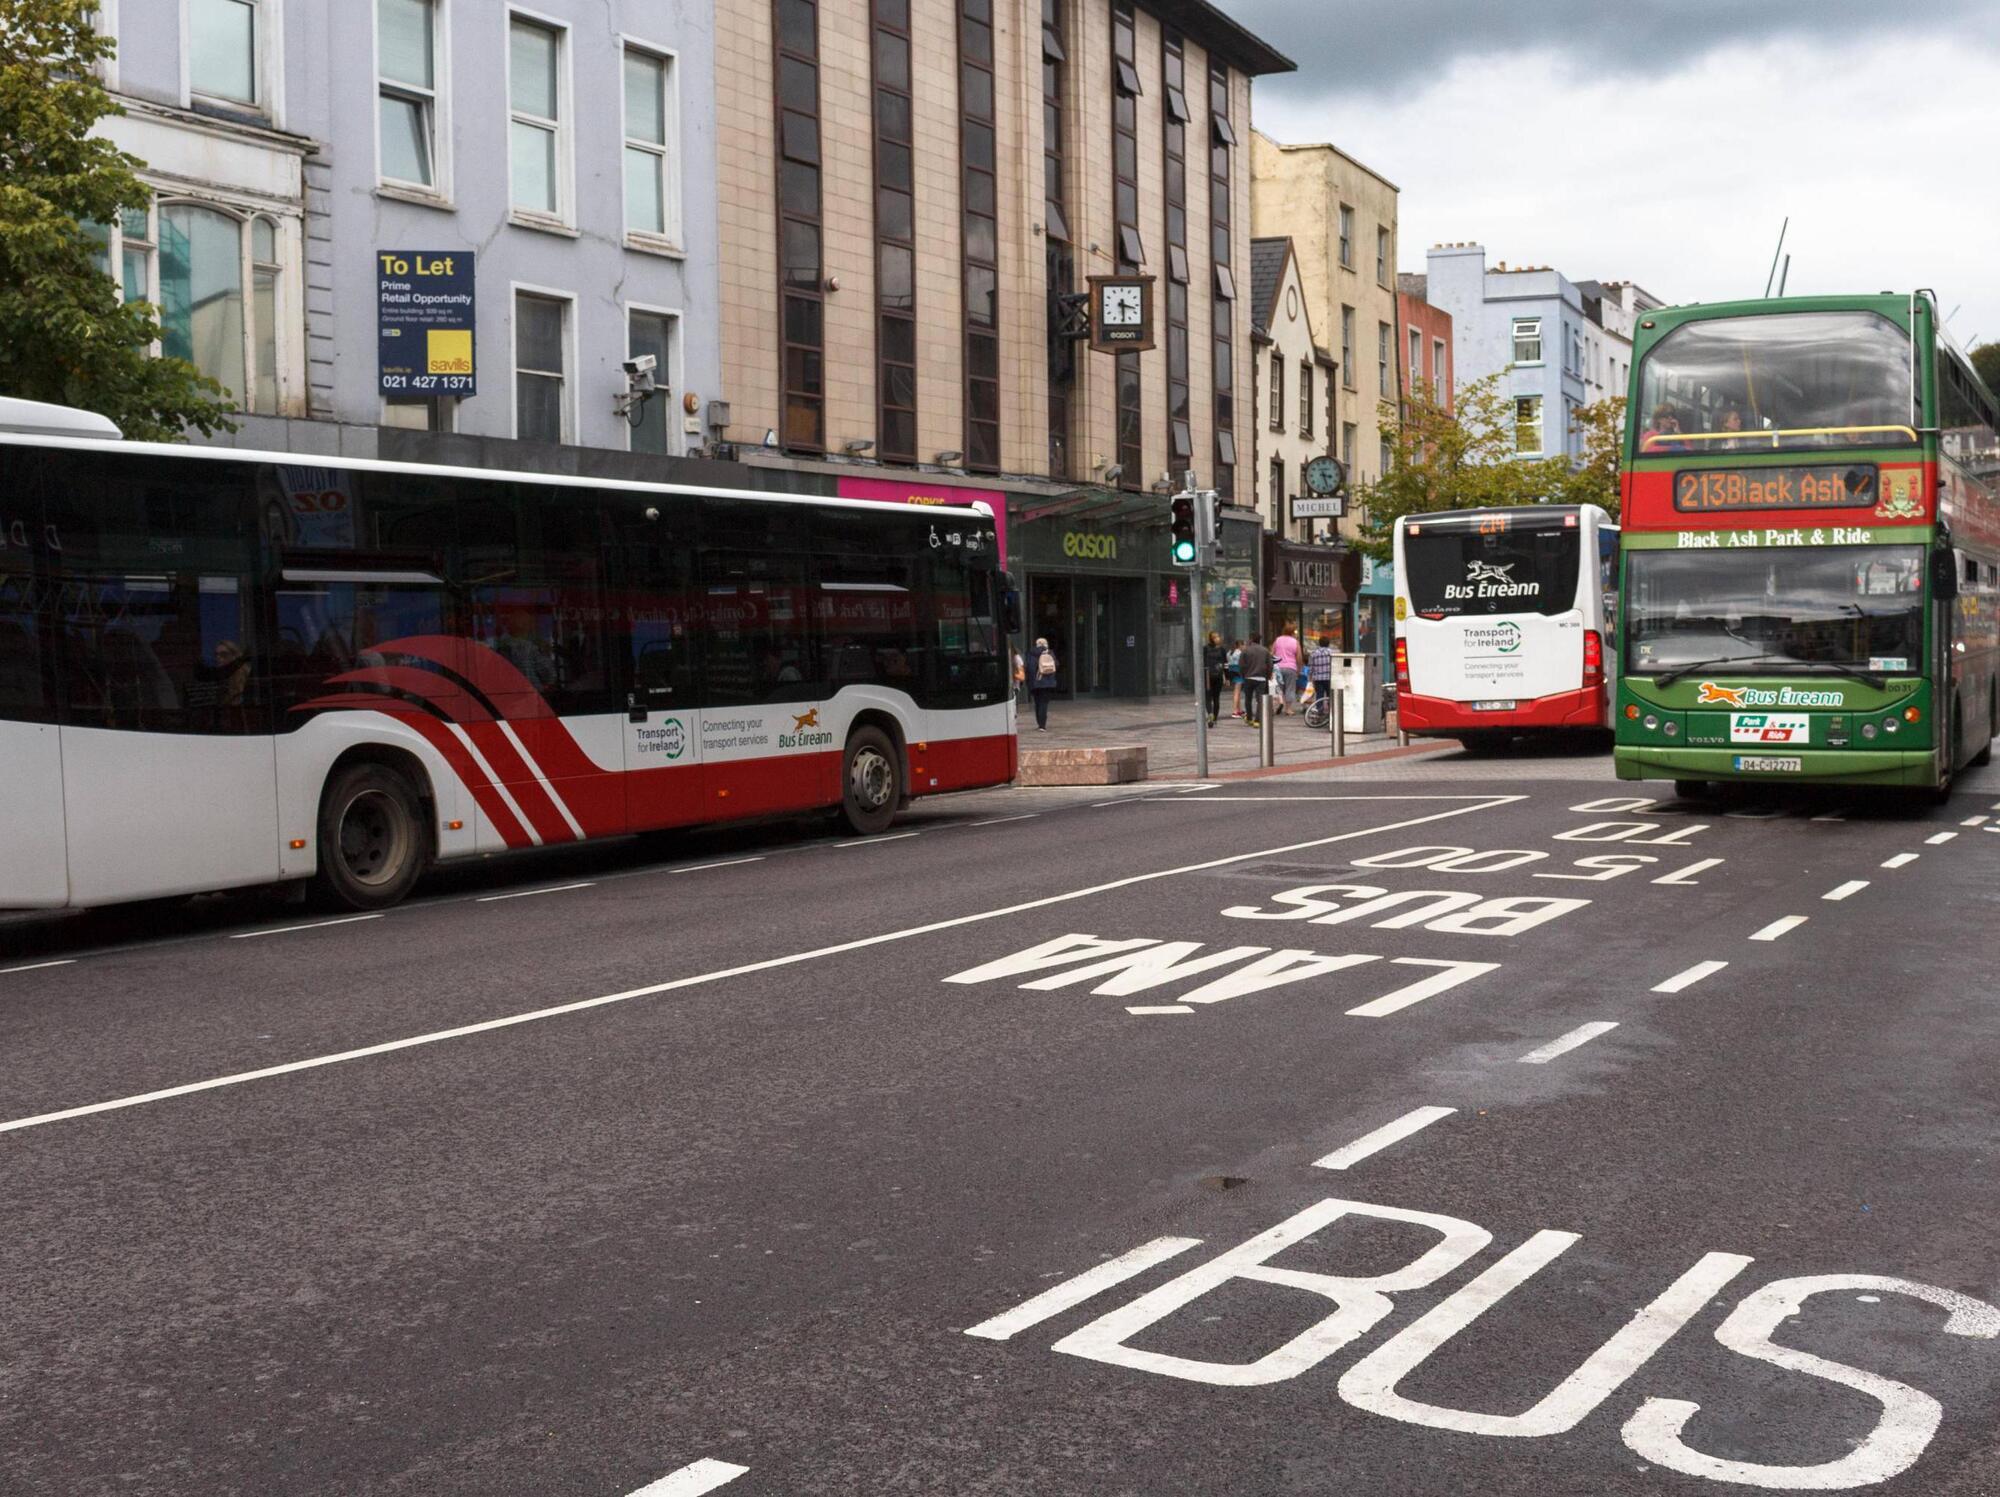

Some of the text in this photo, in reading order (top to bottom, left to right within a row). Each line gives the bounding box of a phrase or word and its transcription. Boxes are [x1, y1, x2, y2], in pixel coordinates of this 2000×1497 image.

[380, 255, 454, 276] To Let
[381, 280, 411, 290] Prime
[381, 293, 472, 305] Retail Opportunity
[1109, 331, 1136, 339] eason
[430, 358, 470, 372] savills
[382, 375, 473, 389] 021 427 1371
[1680, 472, 1846, 508] 213 Black Ash
[1296, 502, 1339, 514] MICHEL
[1677, 526, 1871, 548] Black Ash Park & Ride
[1063, 532, 1117, 560] eason
[1289, 561, 1337, 586] MICHEL
[1444, 583, 1474, 599] Bus
[1463, 628, 1515, 638] Transport
[1463, 638, 1514, 648] for Ireland
[1464, 662, 1519, 672] Connecting your
[1464, 671, 1524, 680] transport services
[1744, 688, 1779, 705] Bus
[702, 718, 763, 733] Connecting your
[1742, 716, 1761, 727] Park
[636, 727, 679, 741] Transport
[1687, 736, 1725, 744] VOLVO
[1766, 729, 1787, 740] Ride
[637, 741, 680, 753] for Ireland
[702, 734, 769, 750] transport services
[778, 734, 797, 749] Bus
[1221, 885, 1593, 937] BUS
[941, 933, 1502, 1018] LÁNA
[1051, 1197, 2000, 1491] BUS
